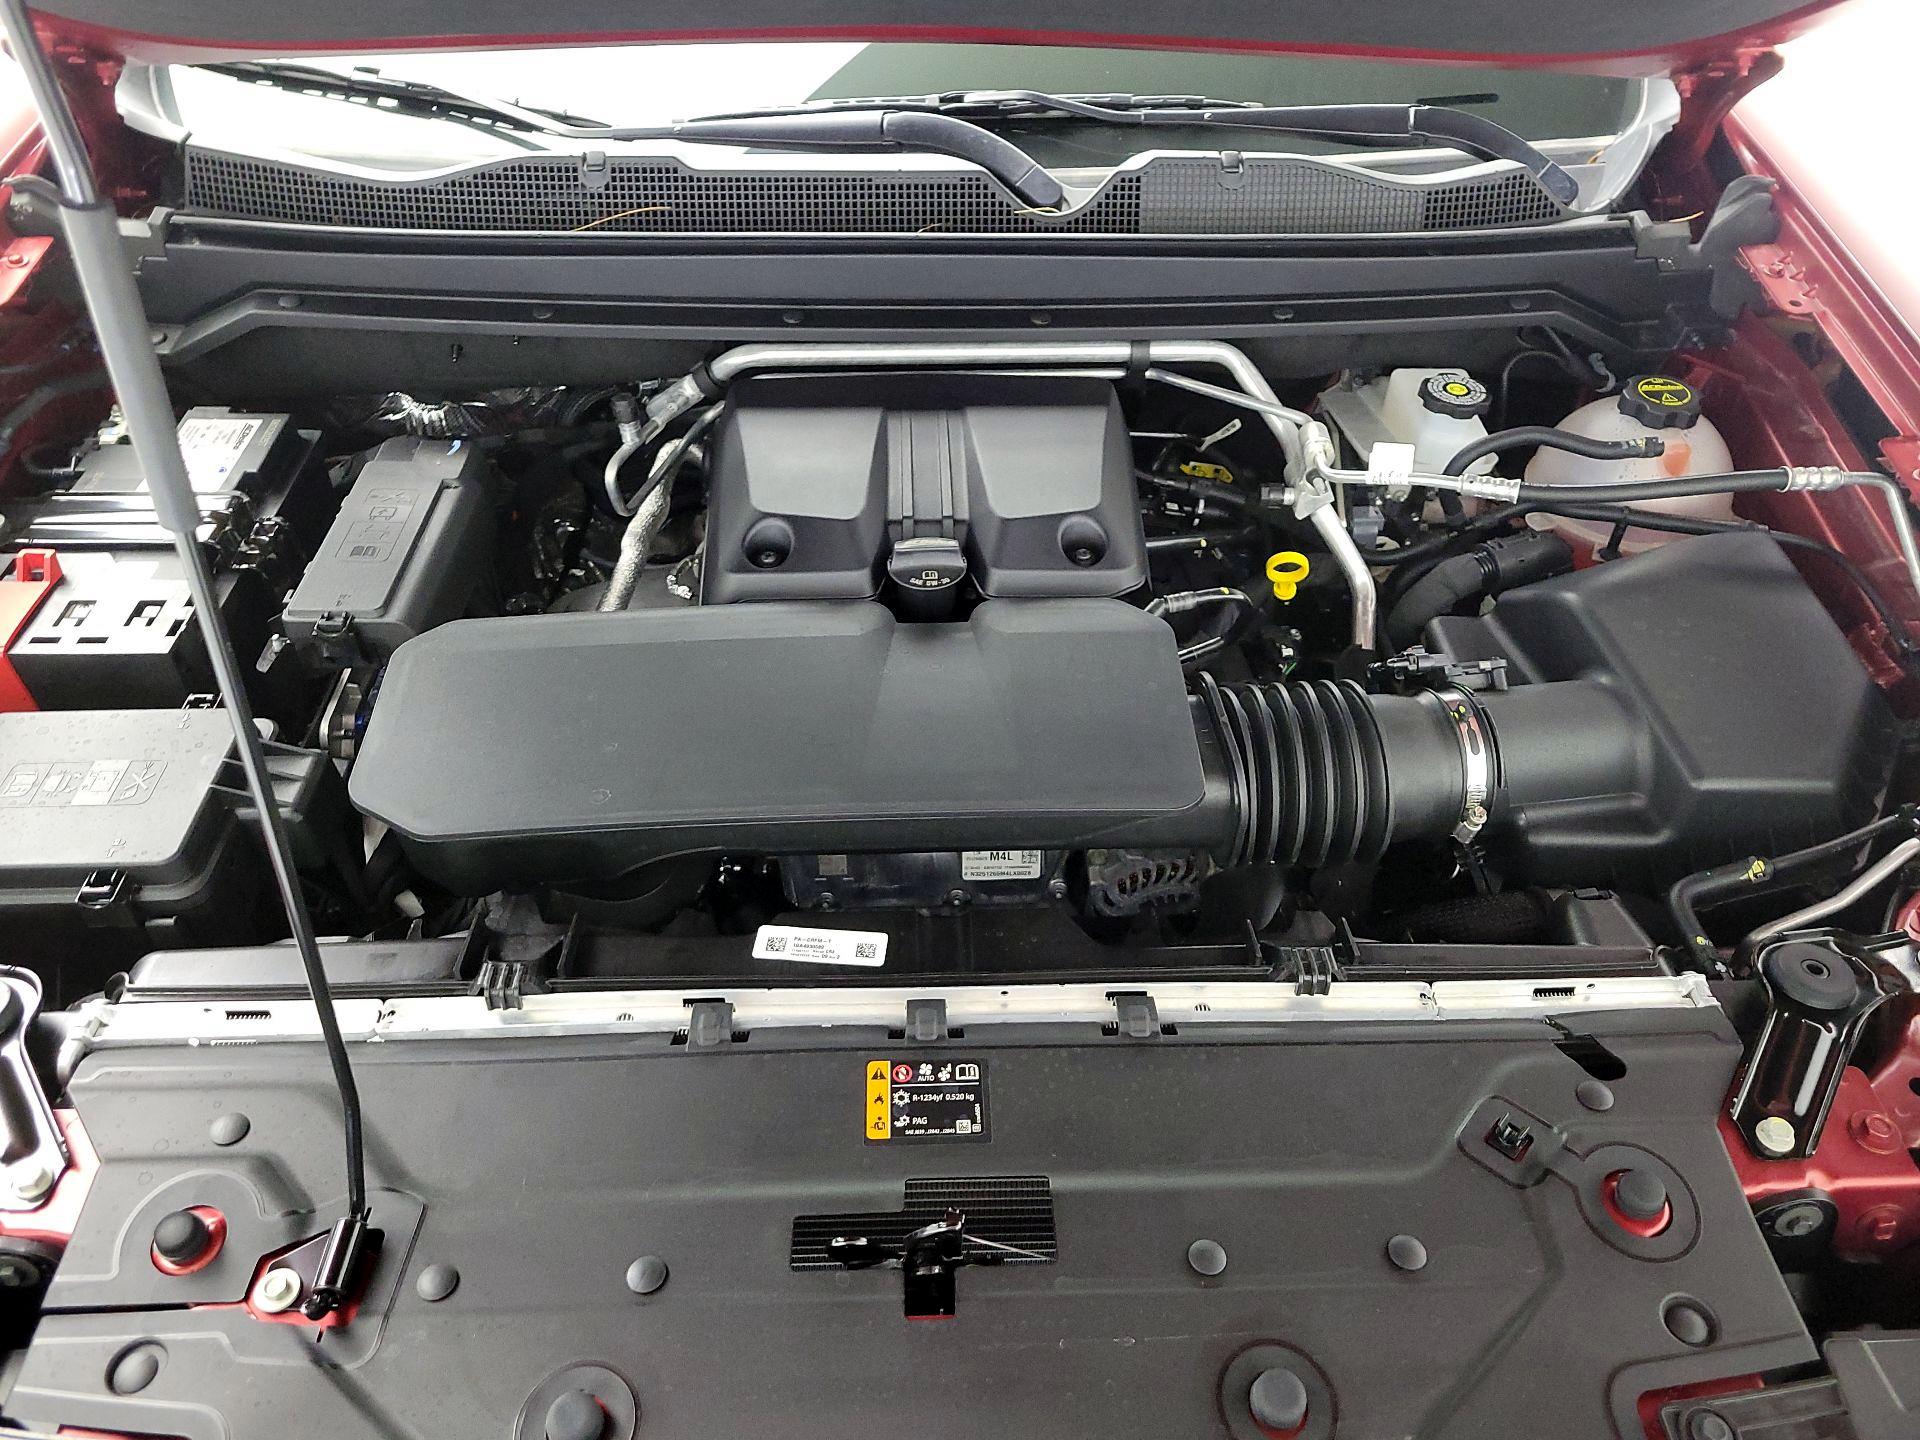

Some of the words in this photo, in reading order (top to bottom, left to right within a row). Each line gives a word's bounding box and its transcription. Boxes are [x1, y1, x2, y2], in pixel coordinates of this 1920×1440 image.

[910, 577, 923, 586] SAE
[989, 851, 1013, 861] M4L
[912, 1093, 944, 1102] R-1234yf
[945, 1092, 965, 1101] 0.520
[965, 1093, 975, 1101] kg
[912, 1117, 928, 1125] PAG
